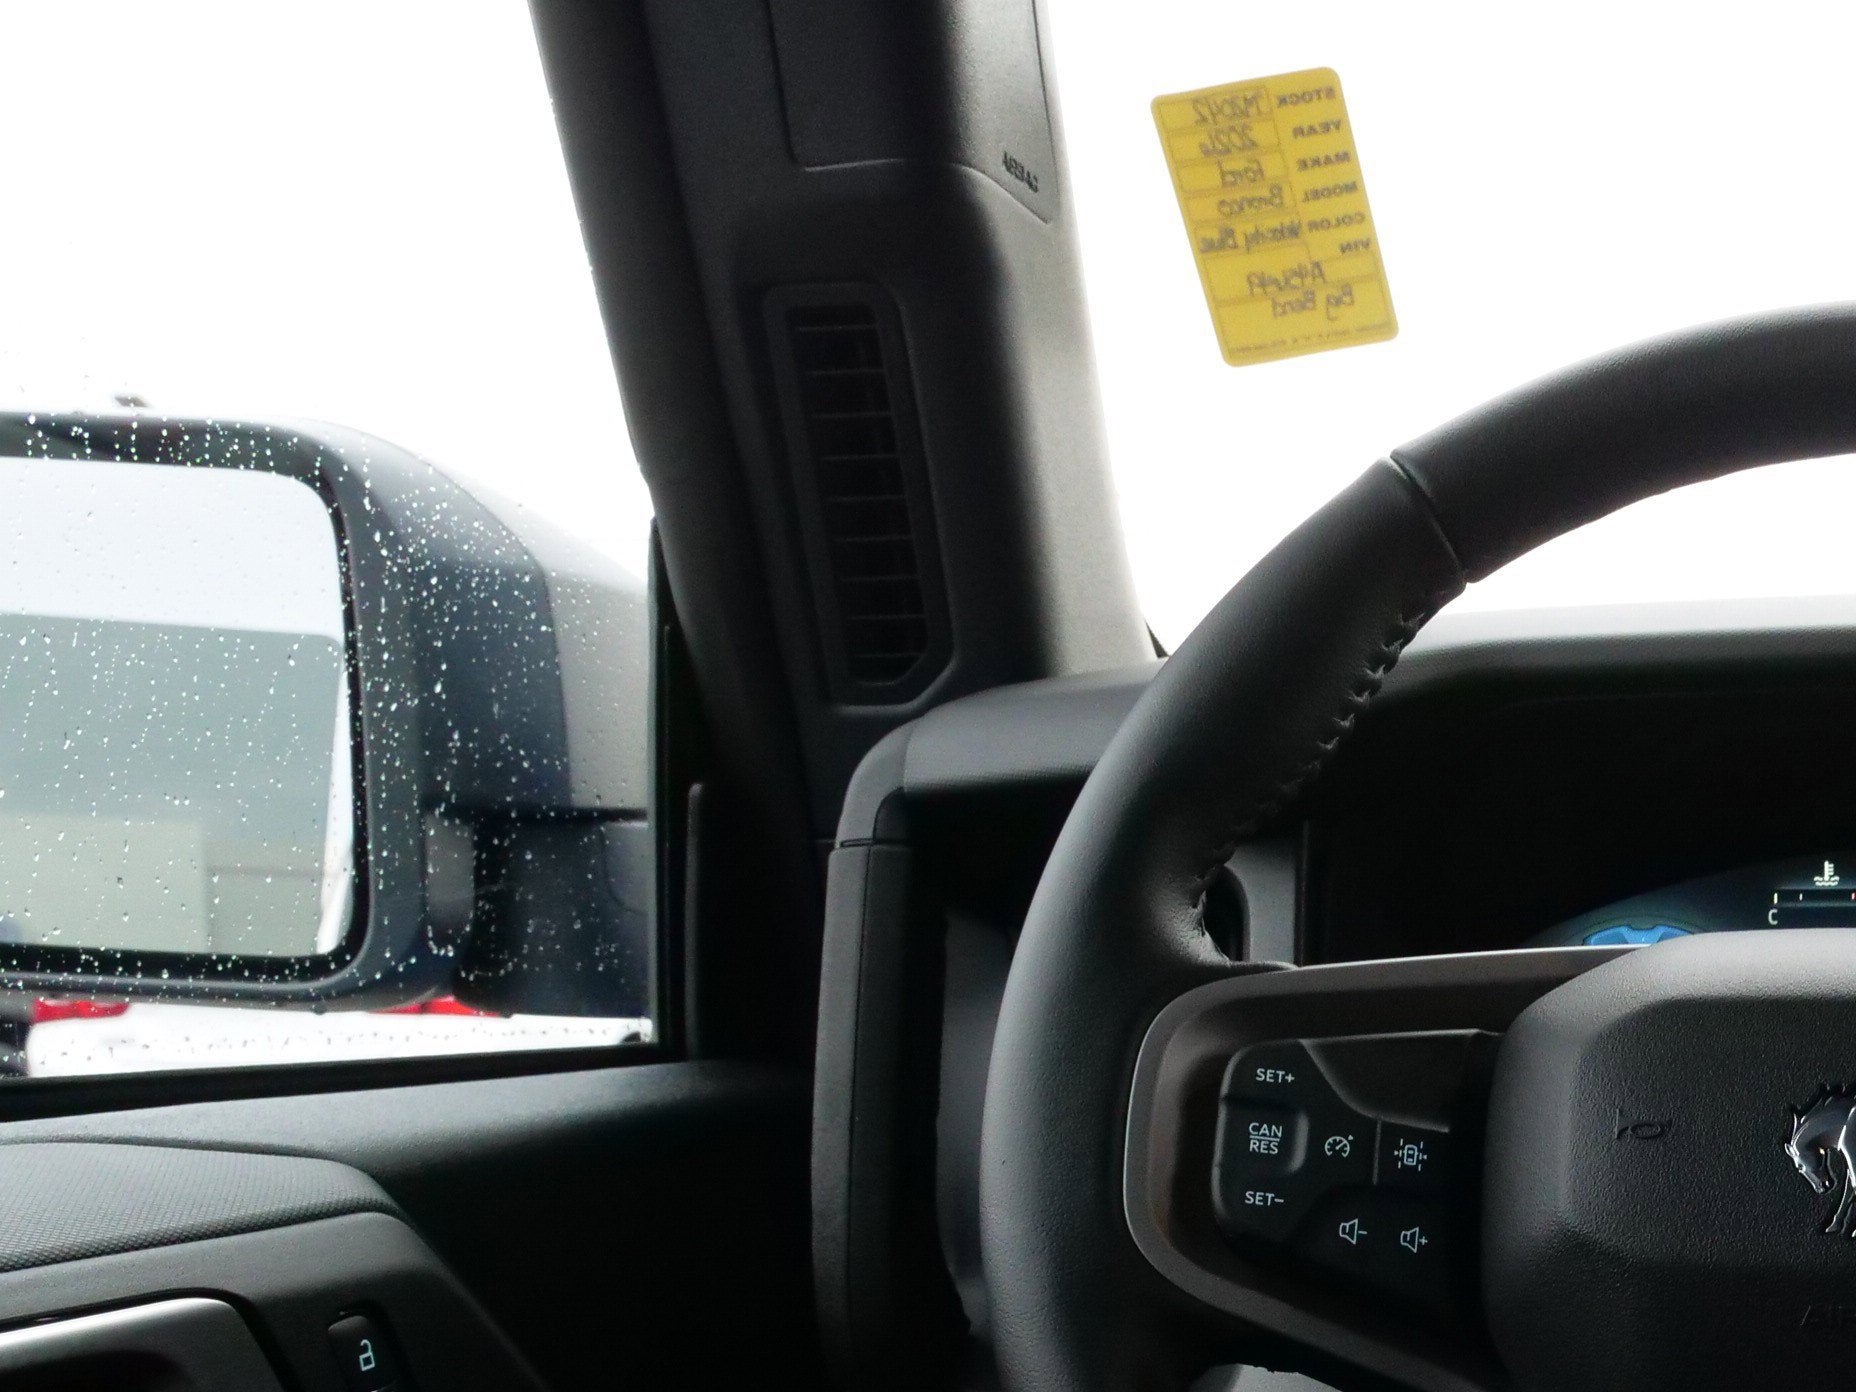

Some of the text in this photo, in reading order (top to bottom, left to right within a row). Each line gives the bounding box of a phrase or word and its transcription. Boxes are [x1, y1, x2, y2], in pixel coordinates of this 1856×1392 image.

[1768, 908, 1778, 925] C
[1255, 1067, 1295, 1084] SET+
[1248, 1122, 1283, 1137] CAN
[1249, 1140, 1279, 1155] RES
